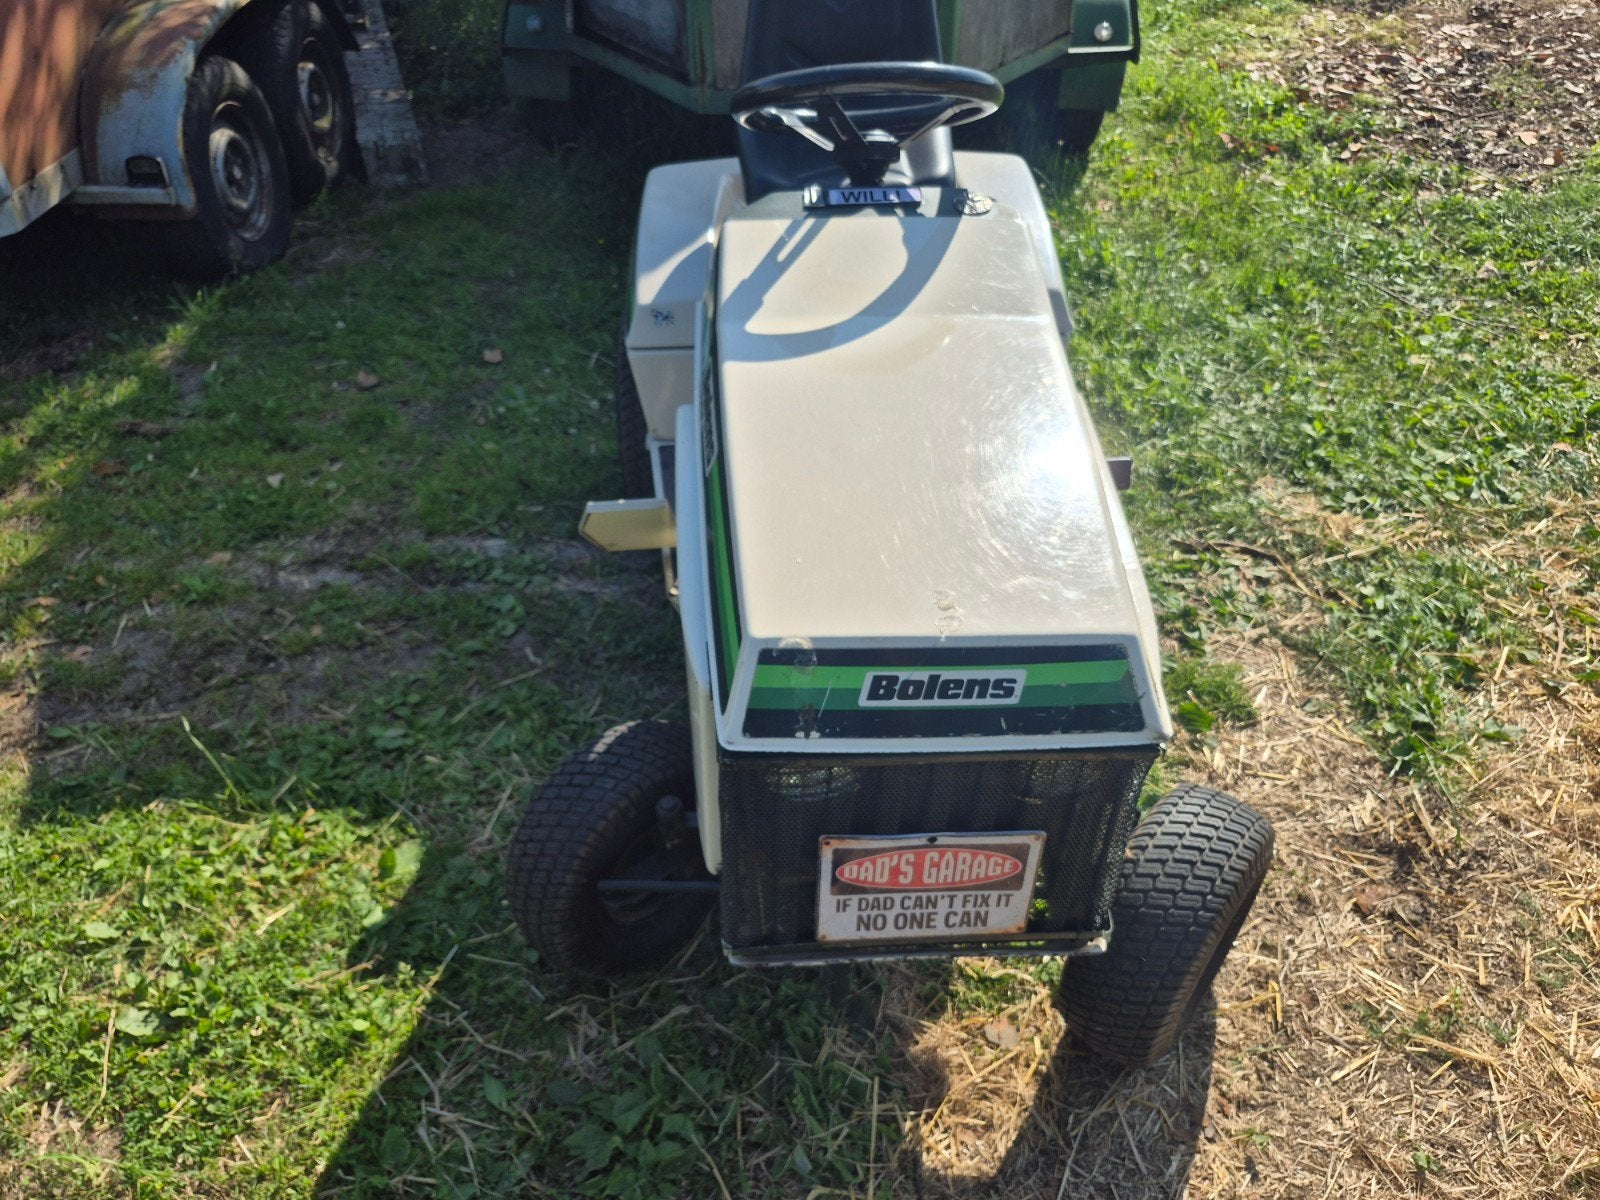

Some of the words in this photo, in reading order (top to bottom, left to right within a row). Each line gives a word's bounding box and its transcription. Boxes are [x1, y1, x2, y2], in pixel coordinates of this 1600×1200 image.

[866, 674, 1017, 700] Bolens
[843, 853, 914, 884] DAD'S
[922, 851, 1014, 884] GARAGE
[835, 898, 852, 913] IF
[857, 898, 895, 912] DAD
[901, 895, 957, 911] CAN'T
[961, 893, 991, 908] FIX
[995, 893, 1014, 907] IT
[856, 915, 887, 931] NO
[893, 912, 937, 930] ONE
[943, 910, 989, 928] CAN
